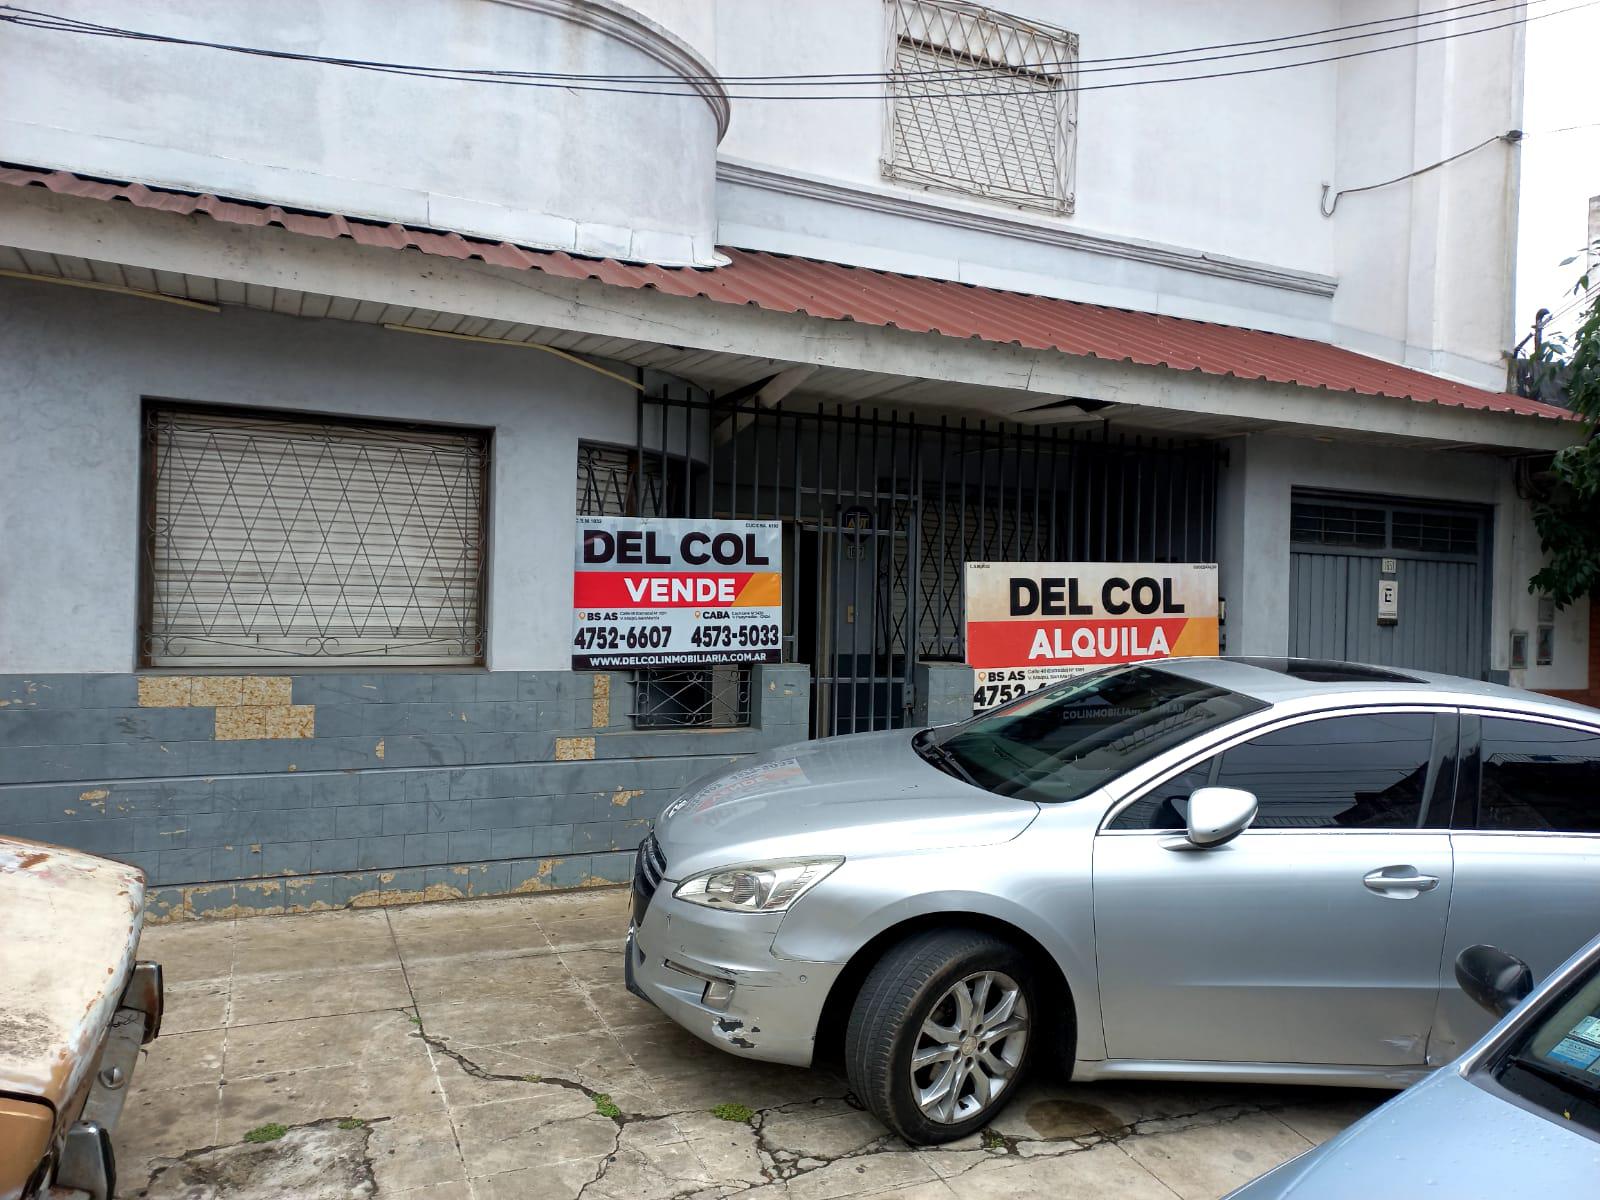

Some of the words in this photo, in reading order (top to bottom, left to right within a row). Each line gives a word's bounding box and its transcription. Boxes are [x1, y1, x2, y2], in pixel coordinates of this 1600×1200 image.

[583, 529, 671, 565] DEL
[680, 531, 769, 566] COL
[623, 577, 736, 602] VENDE
[1009, 577, 1093, 616] DEL
[1101, 577, 1185, 615] COL
[587, 612, 601, 621] BS
[603, 612, 618, 621] AS
[702, 611, 730, 620] CABA
[574, 625, 672, 650] 4752-6607
[691, 624, 779, 648] 4573-5033
[1028, 625, 1171, 660] ALQUILA
[589, 653, 767, 667] WWW.DELCOLINMOBILIARIA.COM.AR
[988, 672, 1005, 682] BS
[1008, 671, 1025, 681] AS
